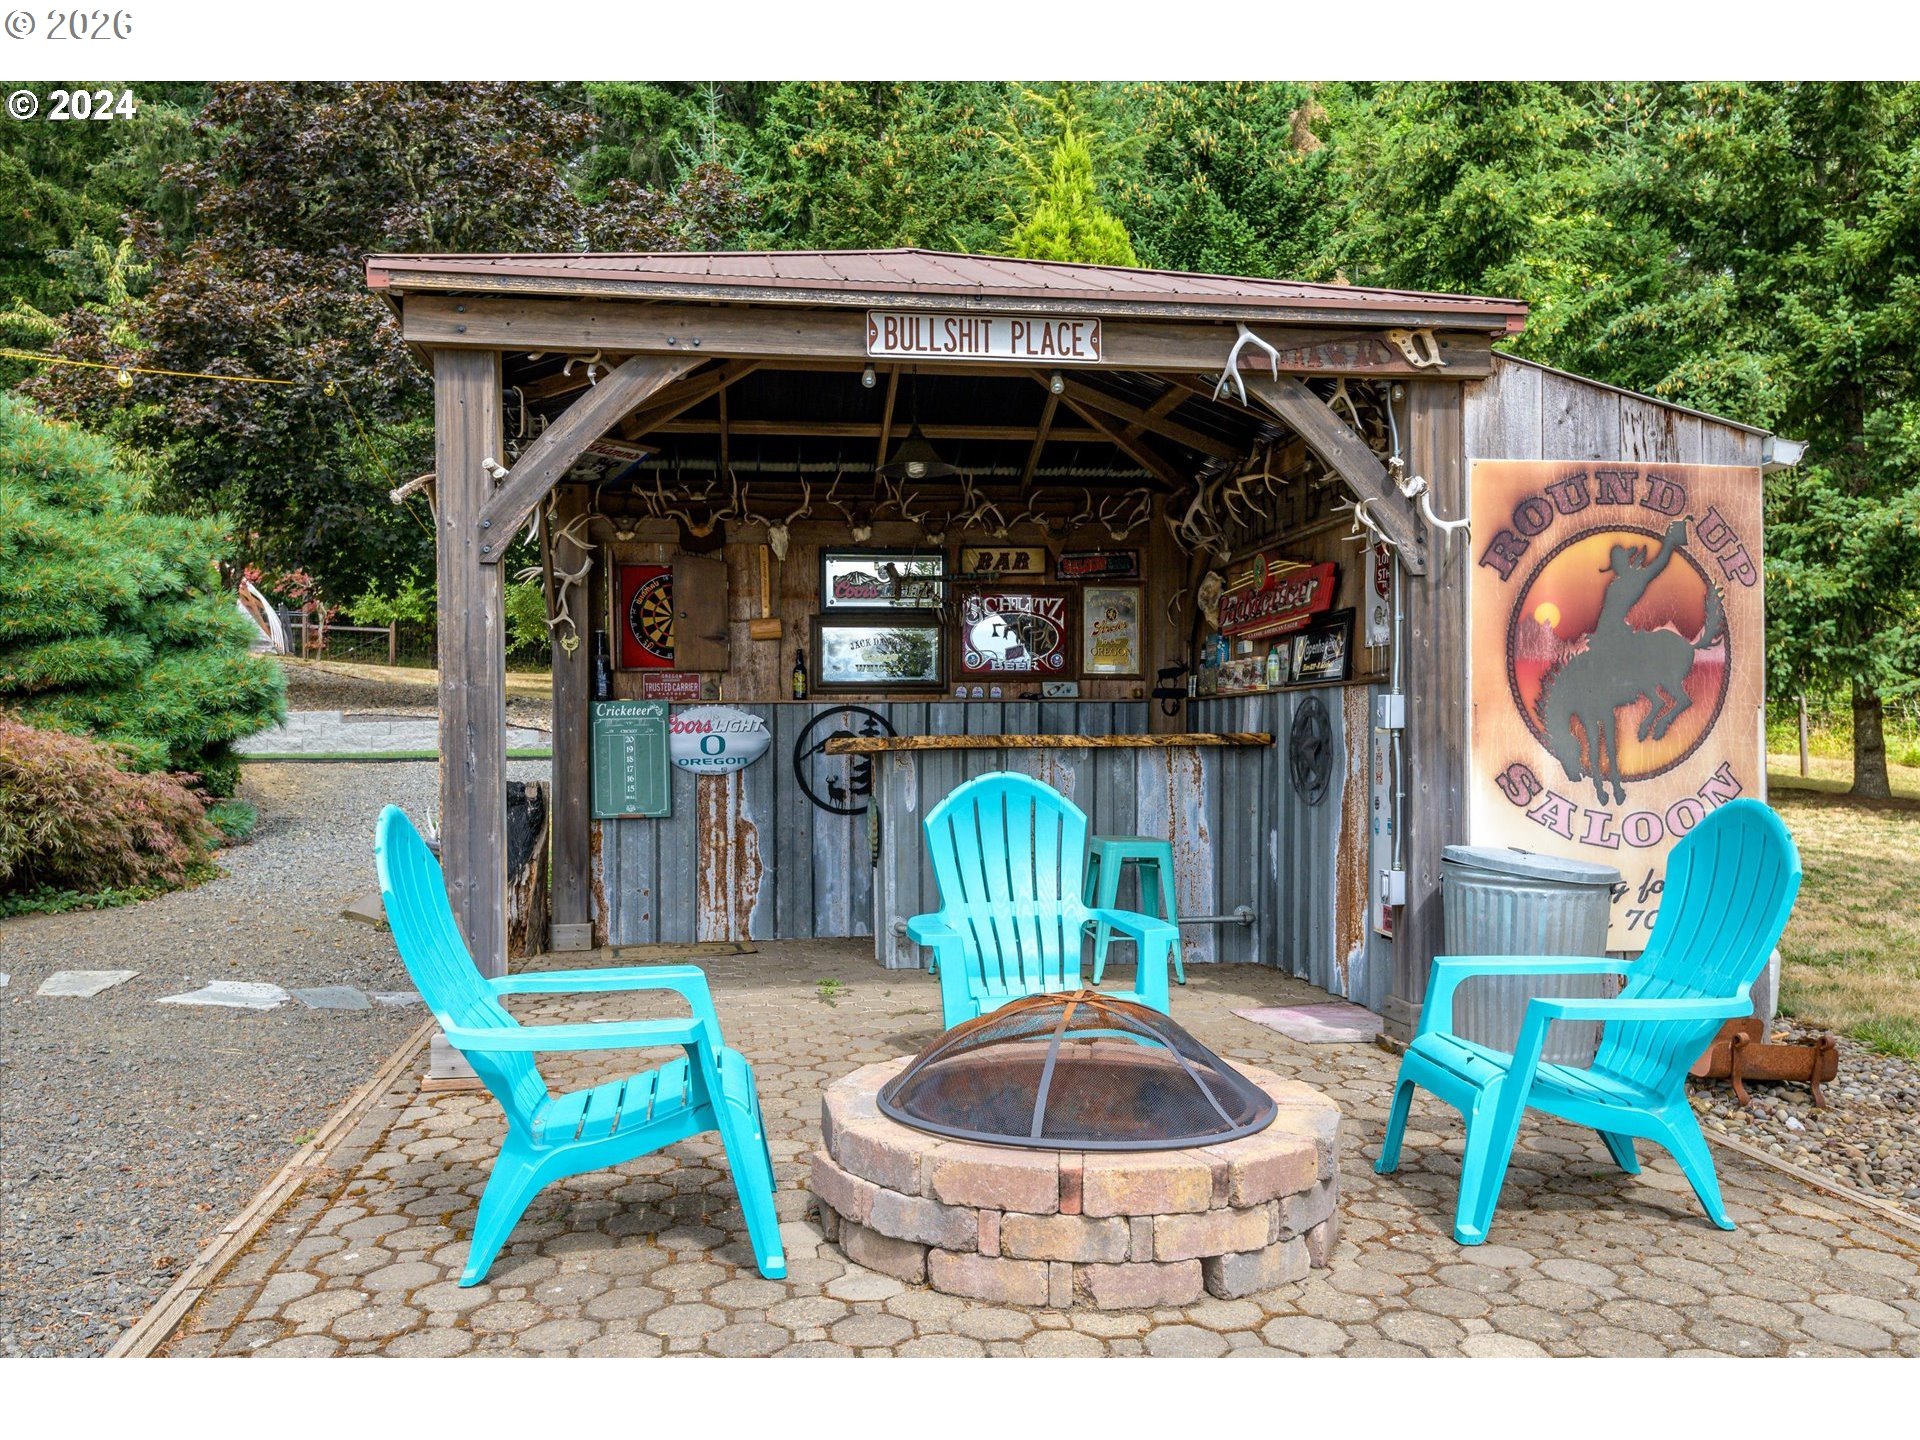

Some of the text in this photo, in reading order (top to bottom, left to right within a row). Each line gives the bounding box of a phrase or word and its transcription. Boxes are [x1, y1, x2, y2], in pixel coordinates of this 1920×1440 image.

[884, 316, 1085, 356] BULLSHIT PLACE
[1480, 471, 1758, 587] ROUND UP
[976, 552, 1030, 570] BAR
[834, 581, 878, 598] Coors
[965, 596, 1064, 628] SCHLITZ
[850, 637, 872, 650] JACK
[1090, 647, 1133, 657] OREGON
[990, 660, 1040, 671] BEER
[645, 682, 699, 692] TRUSTED CARRIER
[596, 703, 652, 717] Cricketeer
[669, 714, 762, 734] Coors LIGHT
[700, 735, 726, 756] O
[678, 757, 748, 766] OREGON
[1495, 761, 1742, 850] SALOON
